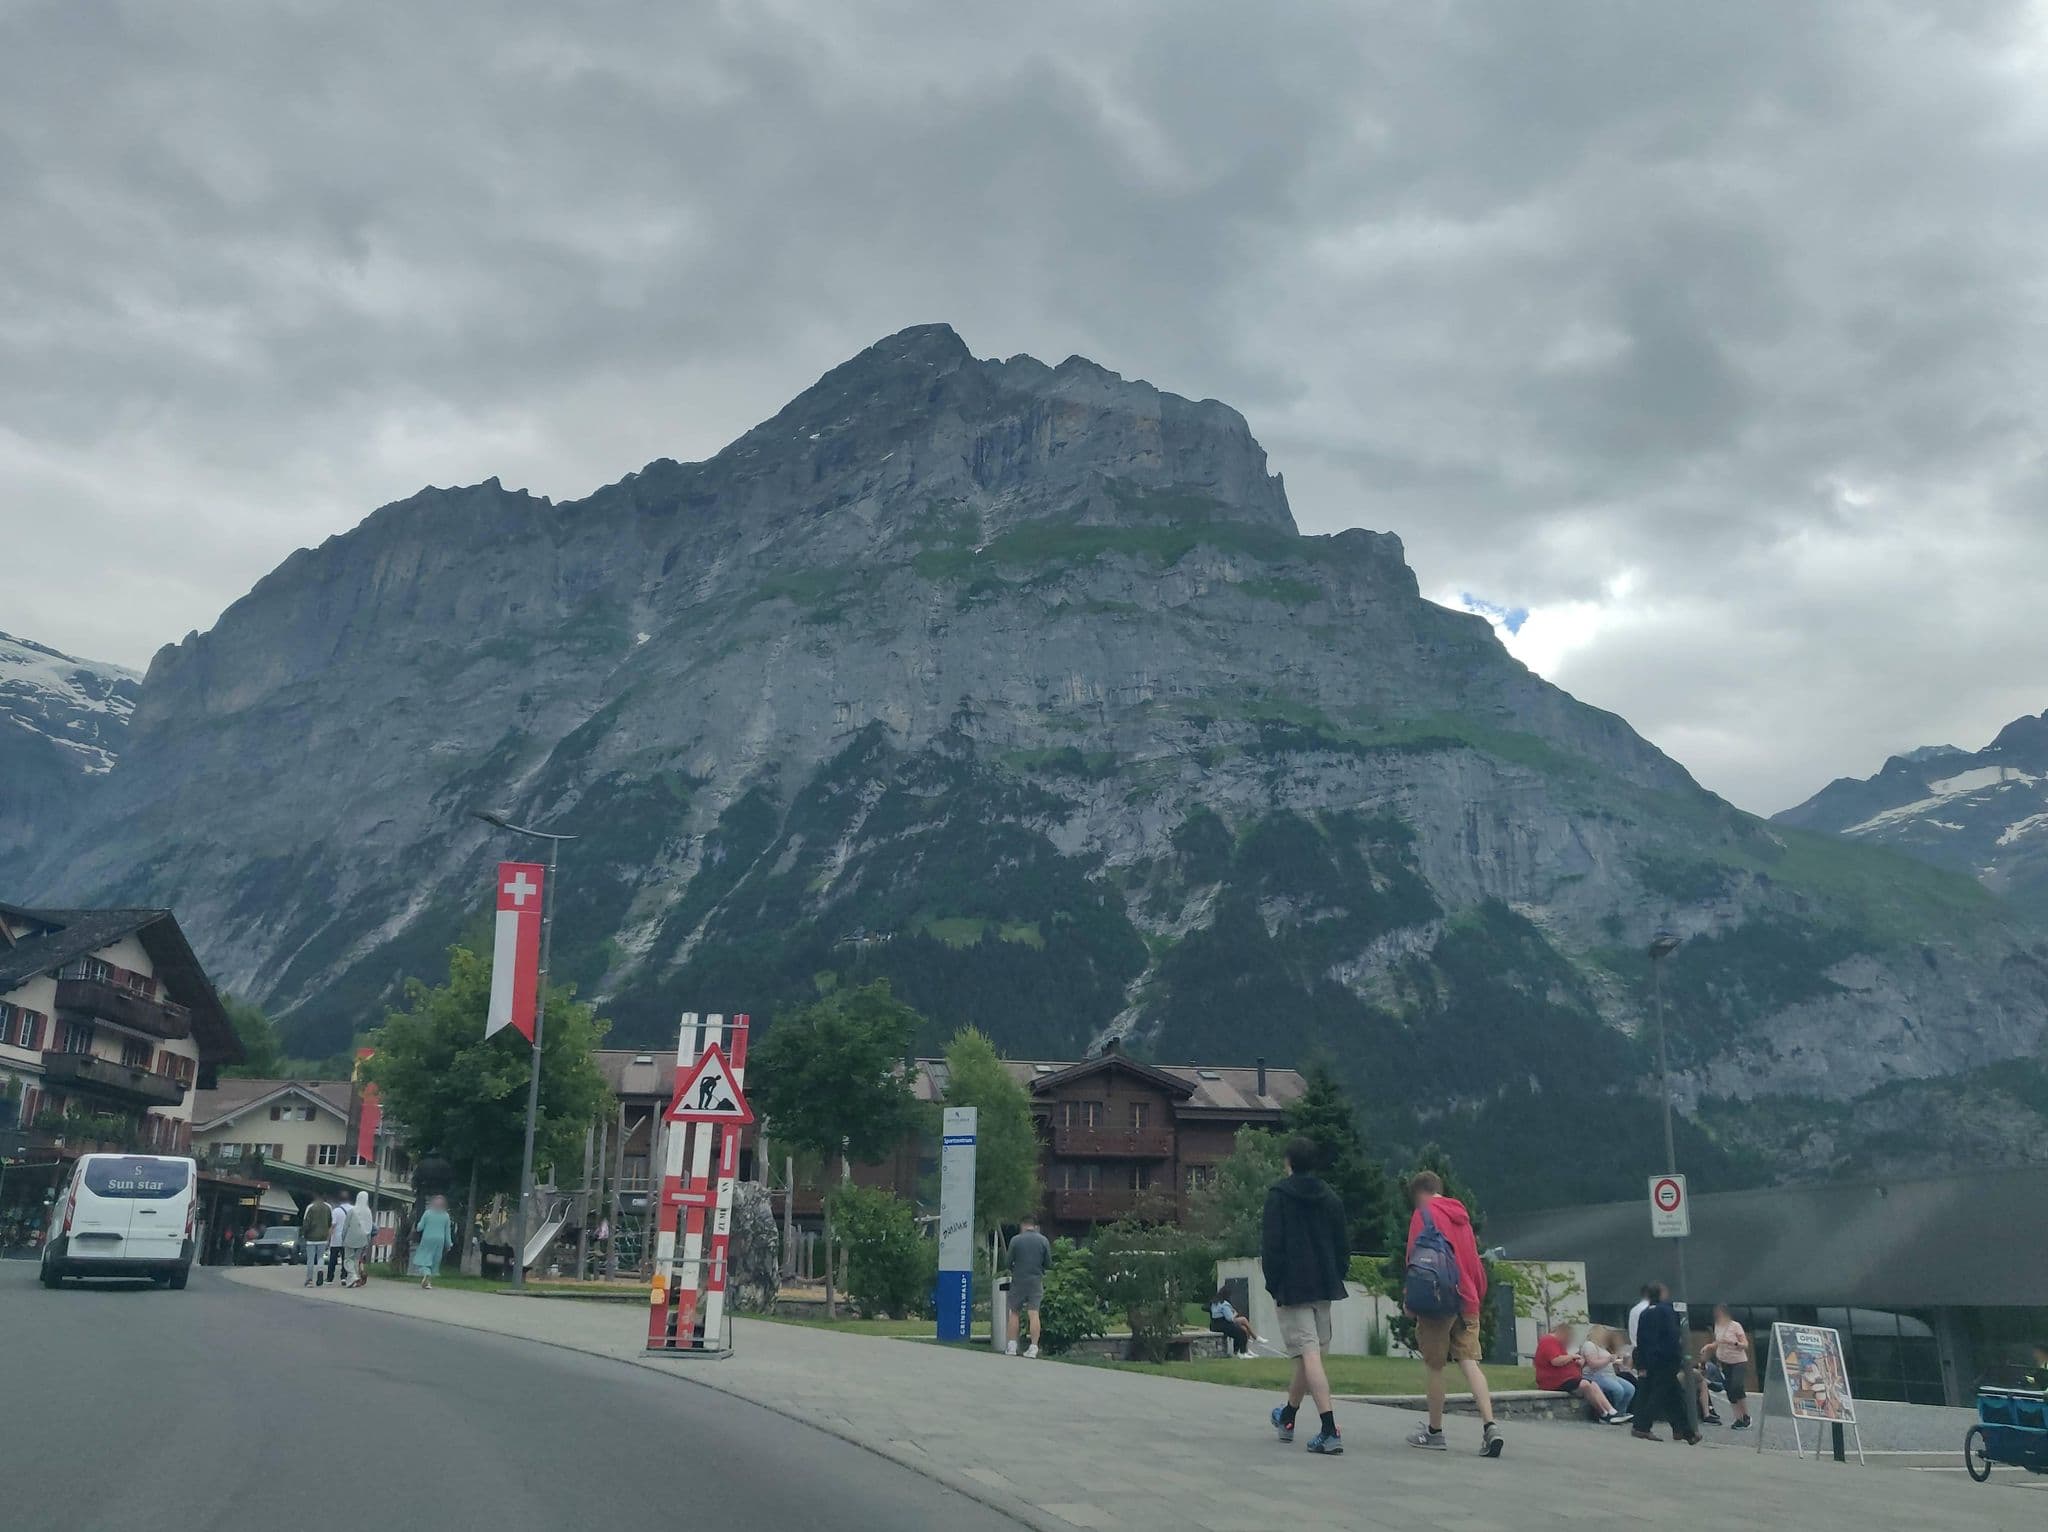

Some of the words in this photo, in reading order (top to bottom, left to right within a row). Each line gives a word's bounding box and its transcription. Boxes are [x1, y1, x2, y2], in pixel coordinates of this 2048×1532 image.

[108, 1179, 134, 1190] Sun
[137, 1180, 163, 1190] star
[1799, 1335, 1820, 1343] OPEN
